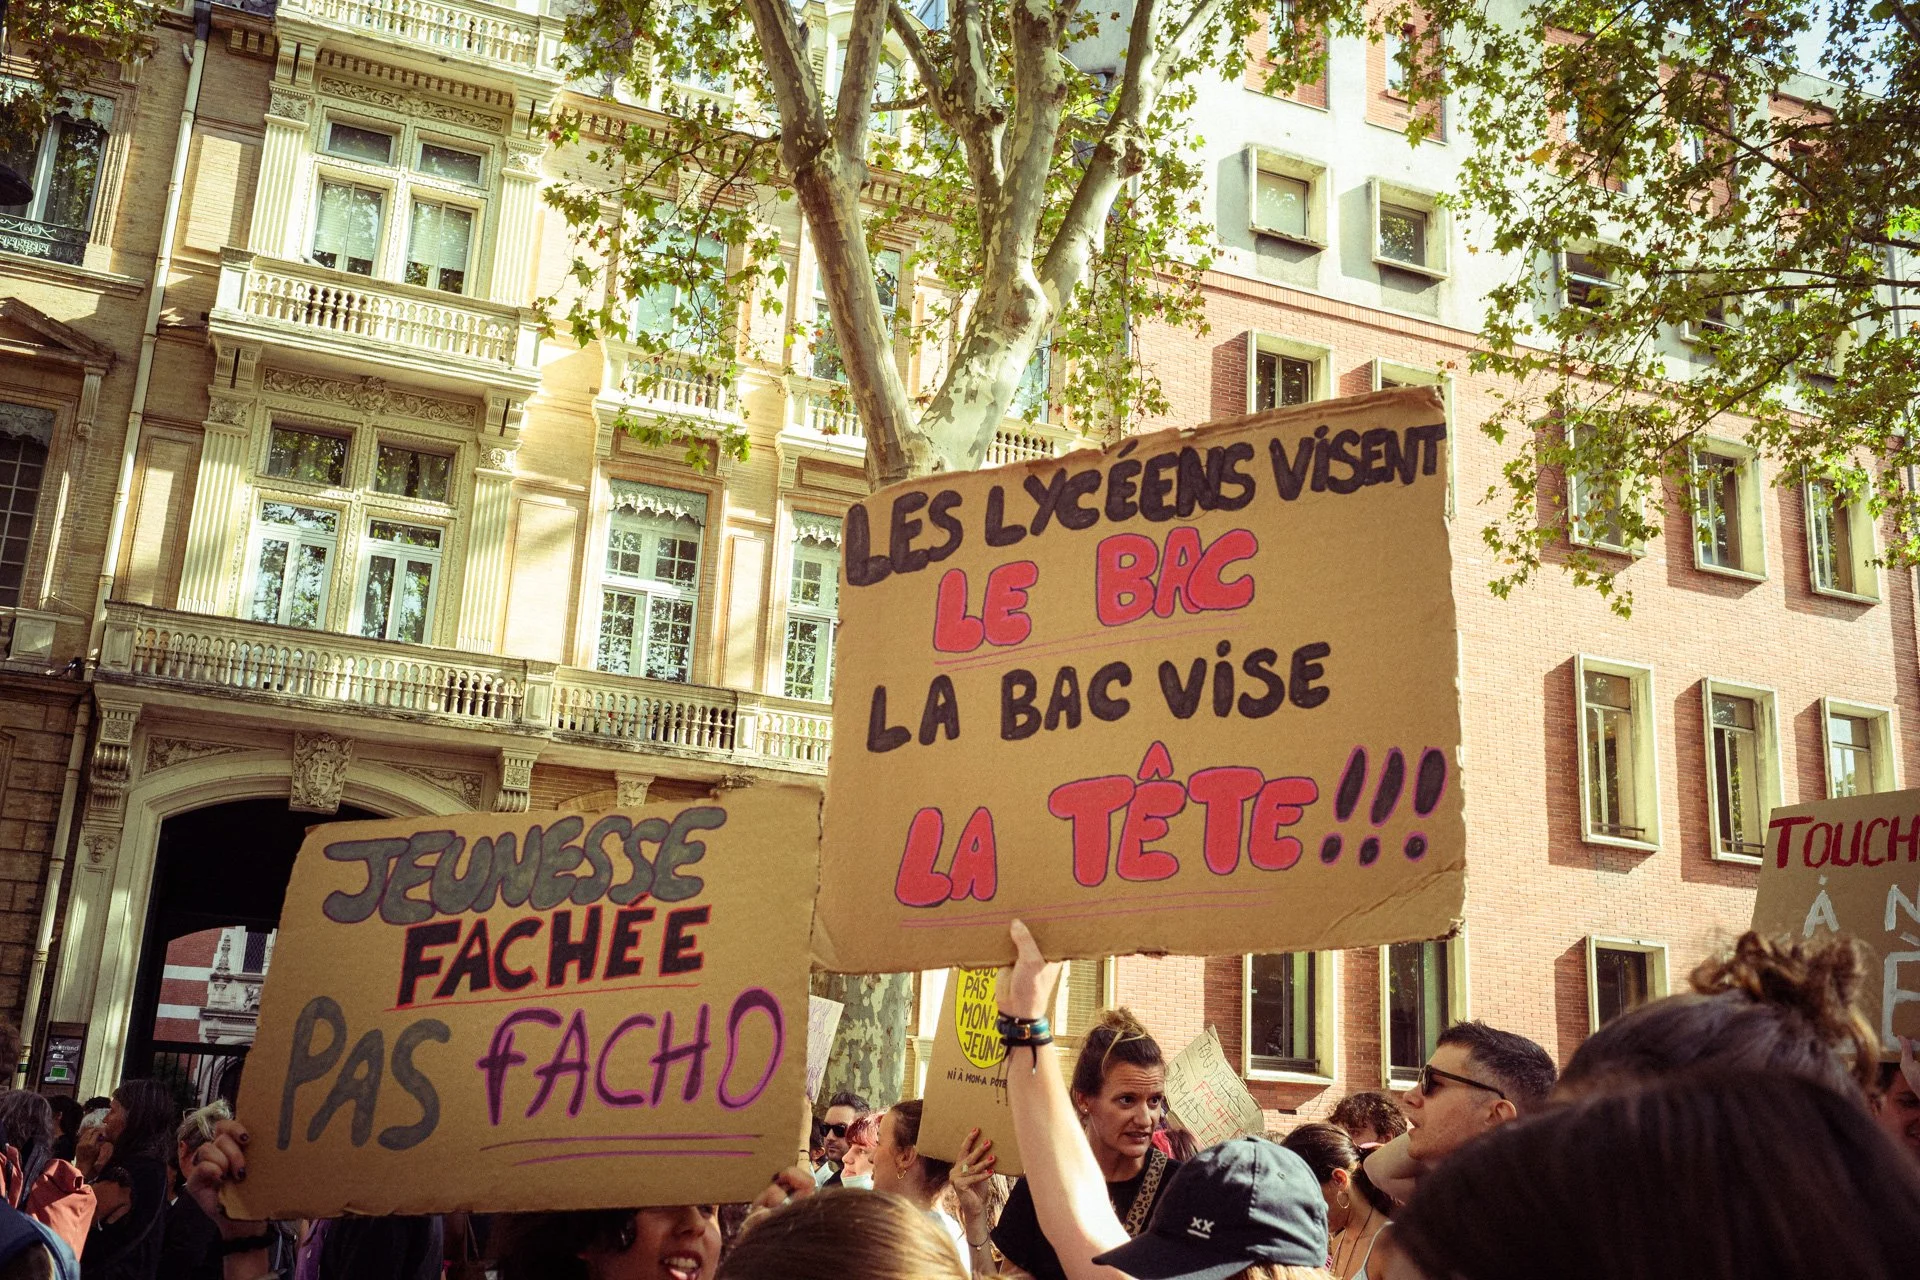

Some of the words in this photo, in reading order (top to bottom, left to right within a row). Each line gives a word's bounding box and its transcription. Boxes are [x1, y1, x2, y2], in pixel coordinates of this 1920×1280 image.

[846, 489, 963, 587] LES
[985, 439, 1256, 547] LYCÉENS
[933, 561, 1038, 652] LE
[1096, 526, 1258, 627] BAC
[866, 674, 960, 752] LA
[1000, 661, 1132, 741] BAC
[322, 806, 727, 924] JEUNESSE
[895, 806, 998, 907] LA
[397, 893, 712, 1008] FACHÉE
[963, 976, 989, 1000] PAS
[276, 996, 452, 1151] PAS
[477, 987, 786, 1126] FACHO
